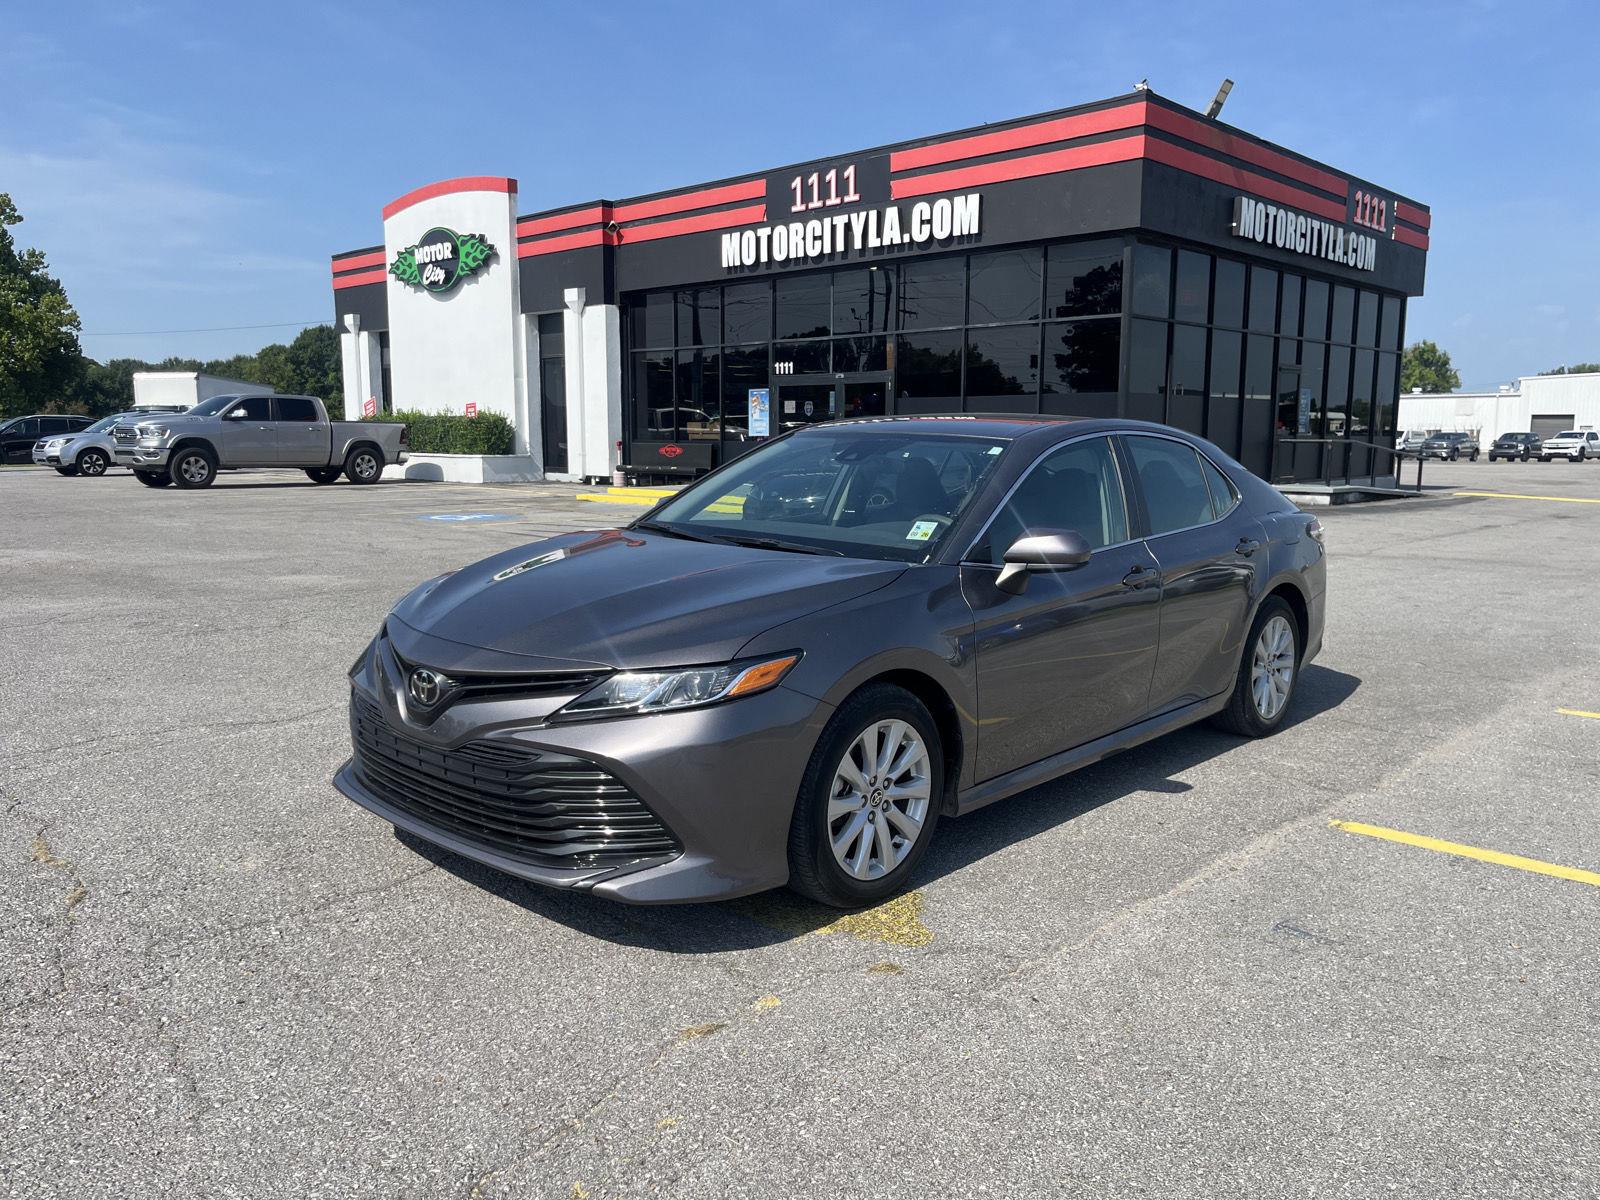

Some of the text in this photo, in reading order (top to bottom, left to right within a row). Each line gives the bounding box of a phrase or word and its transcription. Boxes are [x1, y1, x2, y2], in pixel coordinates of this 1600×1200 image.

[791, 164, 861, 213] 1111
[721, 193, 980, 269] MOTORCITYLA.COM
[1353, 190, 1387, 233] 1111
[415, 242, 452, 264] MOTOR
[1239, 196, 1376, 272] MOTORCITYLA.COM
[423, 264, 445, 285] City
[774, 361, 793, 374] 1111
